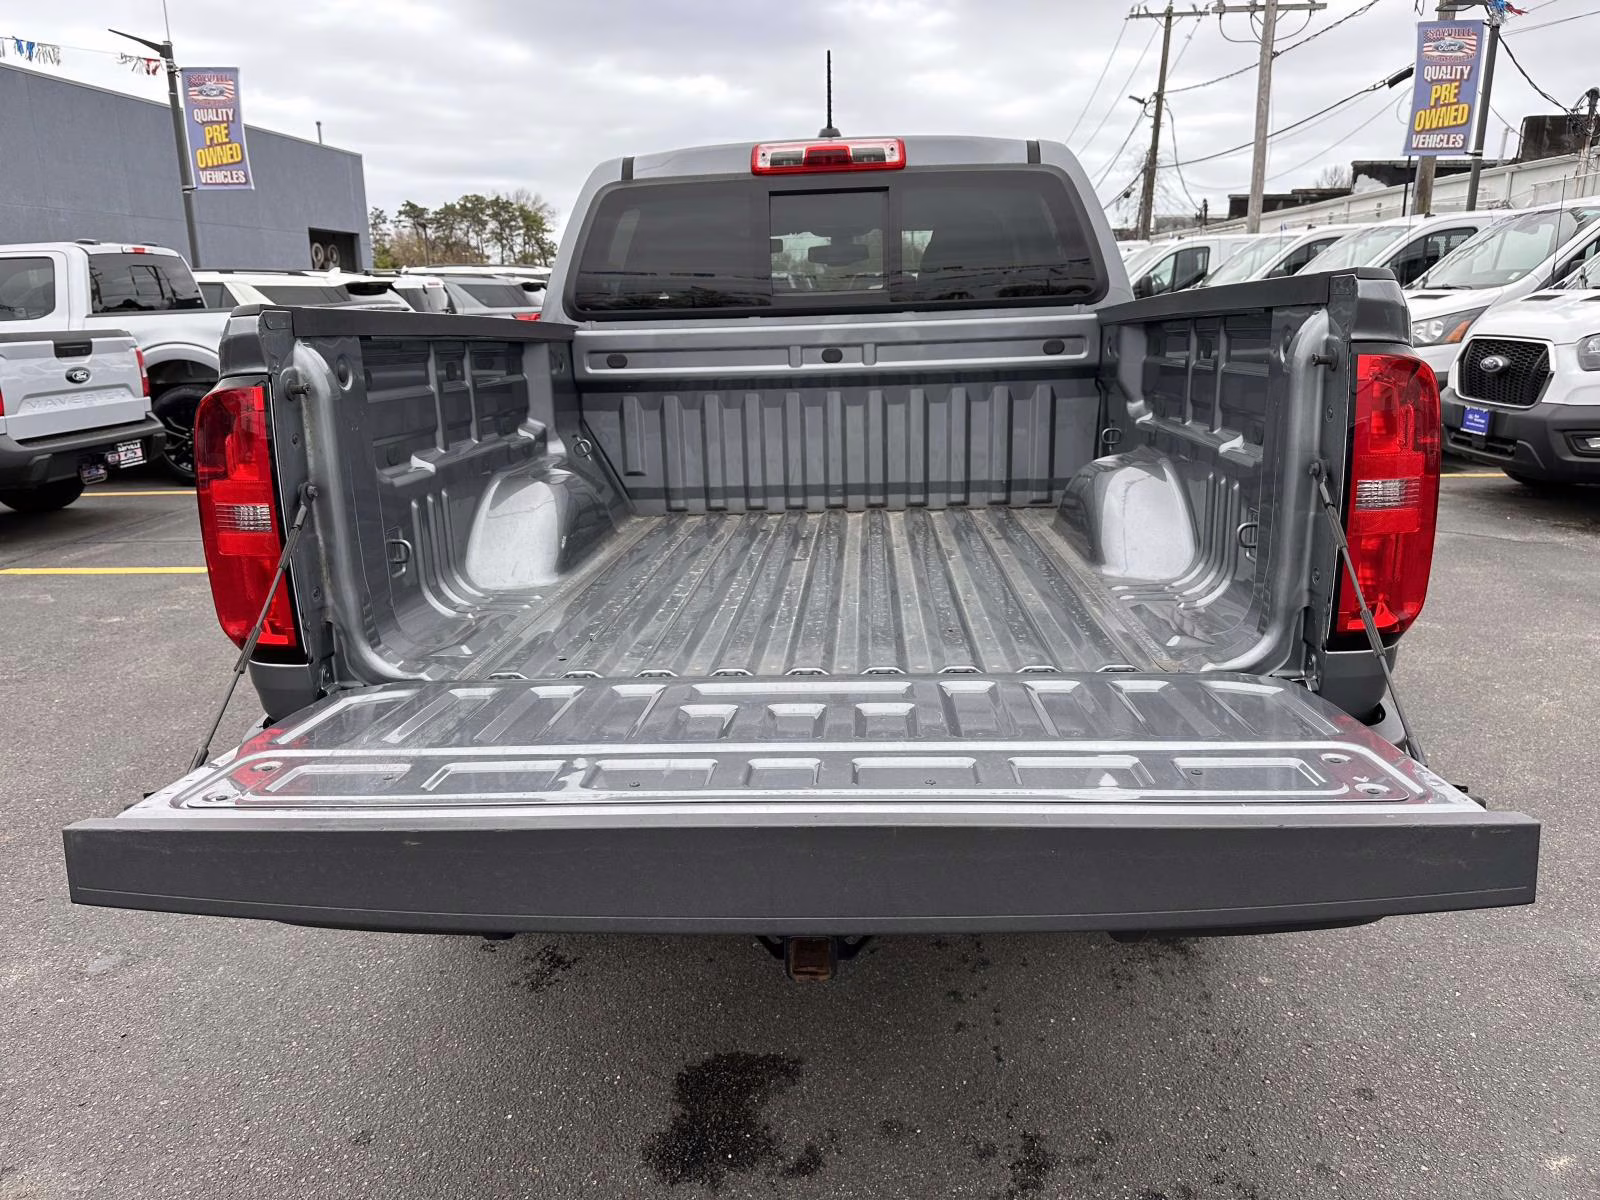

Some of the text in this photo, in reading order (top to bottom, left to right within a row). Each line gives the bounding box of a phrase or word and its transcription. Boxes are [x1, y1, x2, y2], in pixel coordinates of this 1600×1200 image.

[1438, 41, 1460, 51] Ford
[1424, 65, 1471, 82] QUALITY
[1430, 82, 1460, 107] PRE
[193, 108, 234, 124] QUALITY
[1414, 103, 1470, 132] OWNED
[204, 123, 230, 146] PRE
[1411, 133, 1465, 149] VEHICLES
[196, 142, 243, 168] OWNED
[199, 169, 247, 184] VEHICLES
